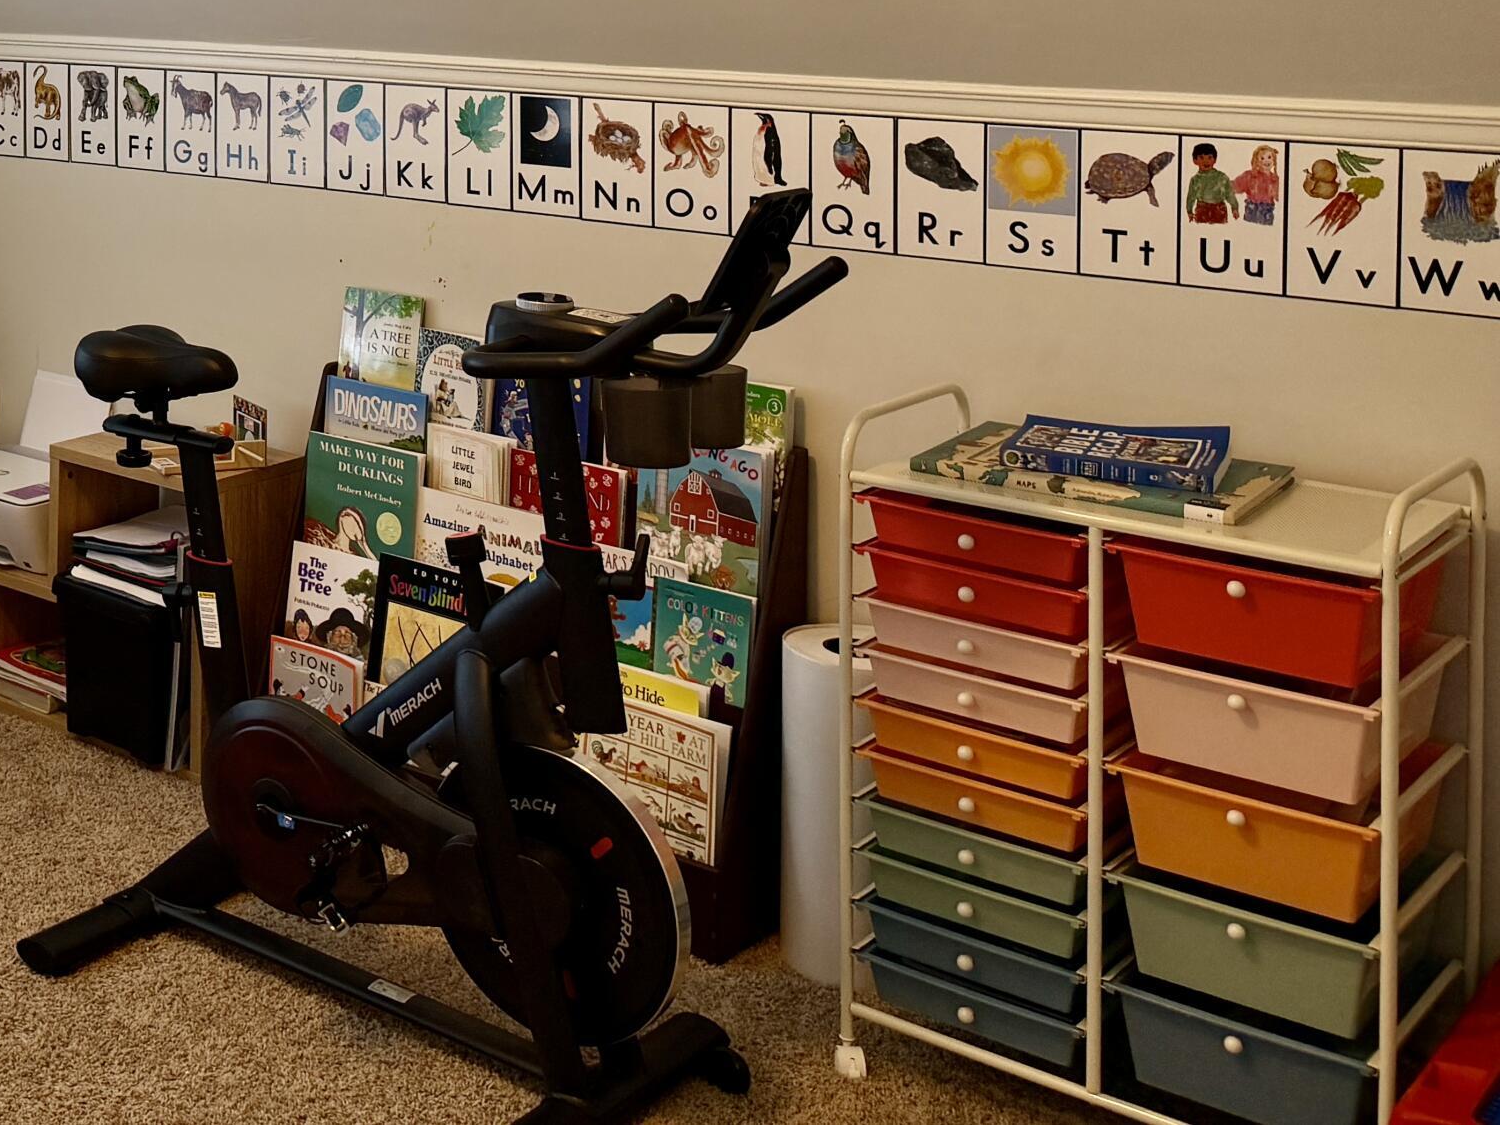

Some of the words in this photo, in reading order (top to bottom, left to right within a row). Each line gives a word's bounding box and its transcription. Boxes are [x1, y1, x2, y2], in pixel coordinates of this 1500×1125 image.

[370, 328, 379, 340] A
[382, 329, 412, 345] TREE
[367, 341, 378, 354] IS
[381, 344, 410, 360] NICE
[433, 354, 454, 369] LITTLE
[334, 388, 418, 431] DINOSAURS
[771, 402, 779, 413] 3
[1054, 427, 1100, 454] BIBLE
[1087, 431, 1125, 458] RECAP
[320, 441, 351, 457] MAKE
[355, 449, 378, 463] WAY
[382, 455, 404, 470] FOR
[452, 445, 476, 460] LITTLE
[338, 461, 404, 486] DUCKLINGS
[452, 461, 475, 475] JEWEL
[730, 459, 759, 480] AGO
[454, 476, 472, 489] BIRD
[1016, 480, 1036, 489] MAPS
[337, 483, 361, 496] Robert
[364, 489, 401, 508] McCloskey
[423, 513, 470, 533] Amazing
[297, 562, 325, 582] Bee
[309, 556, 328, 571] The
[413, 568, 427, 578] ED
[299, 578, 332, 596] Tree
[389, 574, 427, 603] Seven
[428, 584, 464, 613] Blind
[667, 597, 698, 614] COLOR
[702, 606, 745, 626] KITTENS
[290, 651, 336, 677] STONE
[309, 672, 344, 696] SOUP
[389, 677, 443, 726] MERACH
[635, 686, 665, 707] Hide
[628, 713, 664, 737] YEAR
[689, 736, 707, 751] AT
[640, 731, 668, 752] HILL
[671, 745, 707, 767] FARM
[607, 886, 632, 974] MERACH
